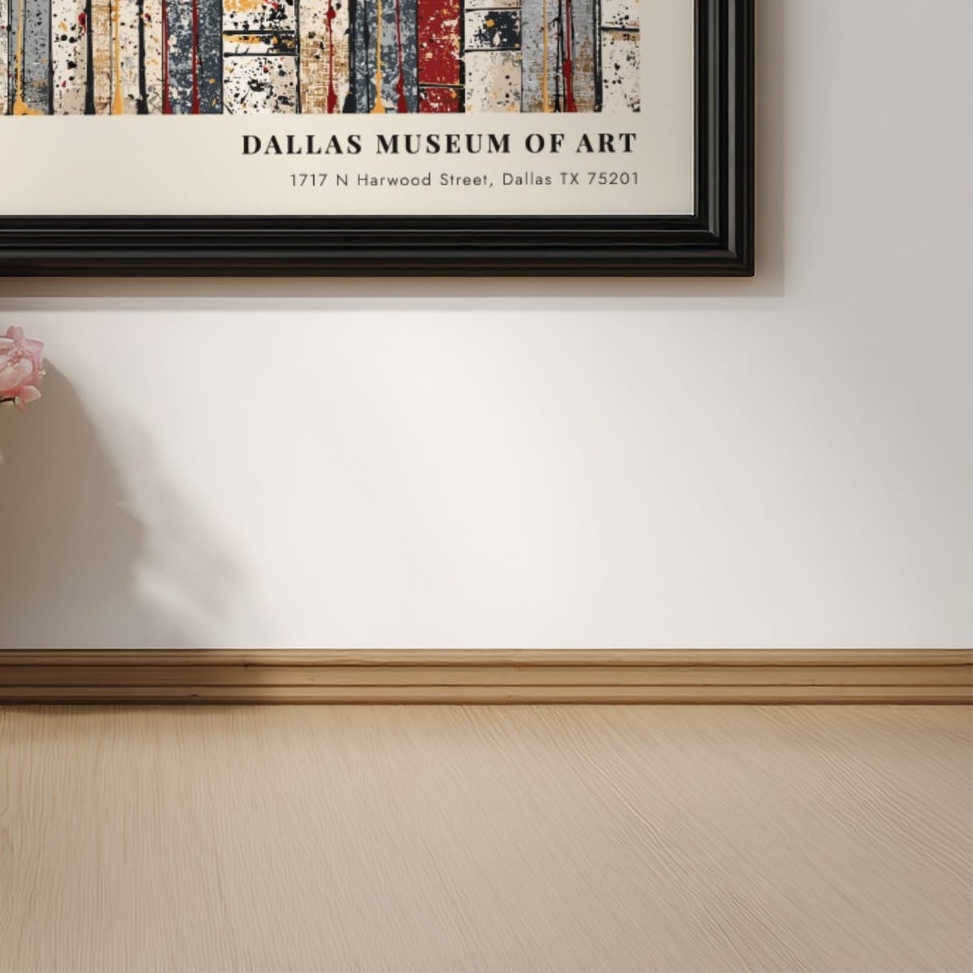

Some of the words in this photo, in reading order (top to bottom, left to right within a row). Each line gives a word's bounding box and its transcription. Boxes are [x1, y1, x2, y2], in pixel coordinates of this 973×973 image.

[242, 134, 362, 155] DALLAS
[375, 133, 511, 154] MUSEUM
[524, 132, 565, 154] OF
[575, 132, 637, 153] ART
[290, 173, 328, 187] 1717
[336, 173, 348, 186] N
[357, 172, 431, 187] Harwood
[440, 172, 493, 188] Street,
[502, 171, 552, 186] Dallas
[560, 171, 579, 186] TX
[587, 171, 639, 186] 75201
